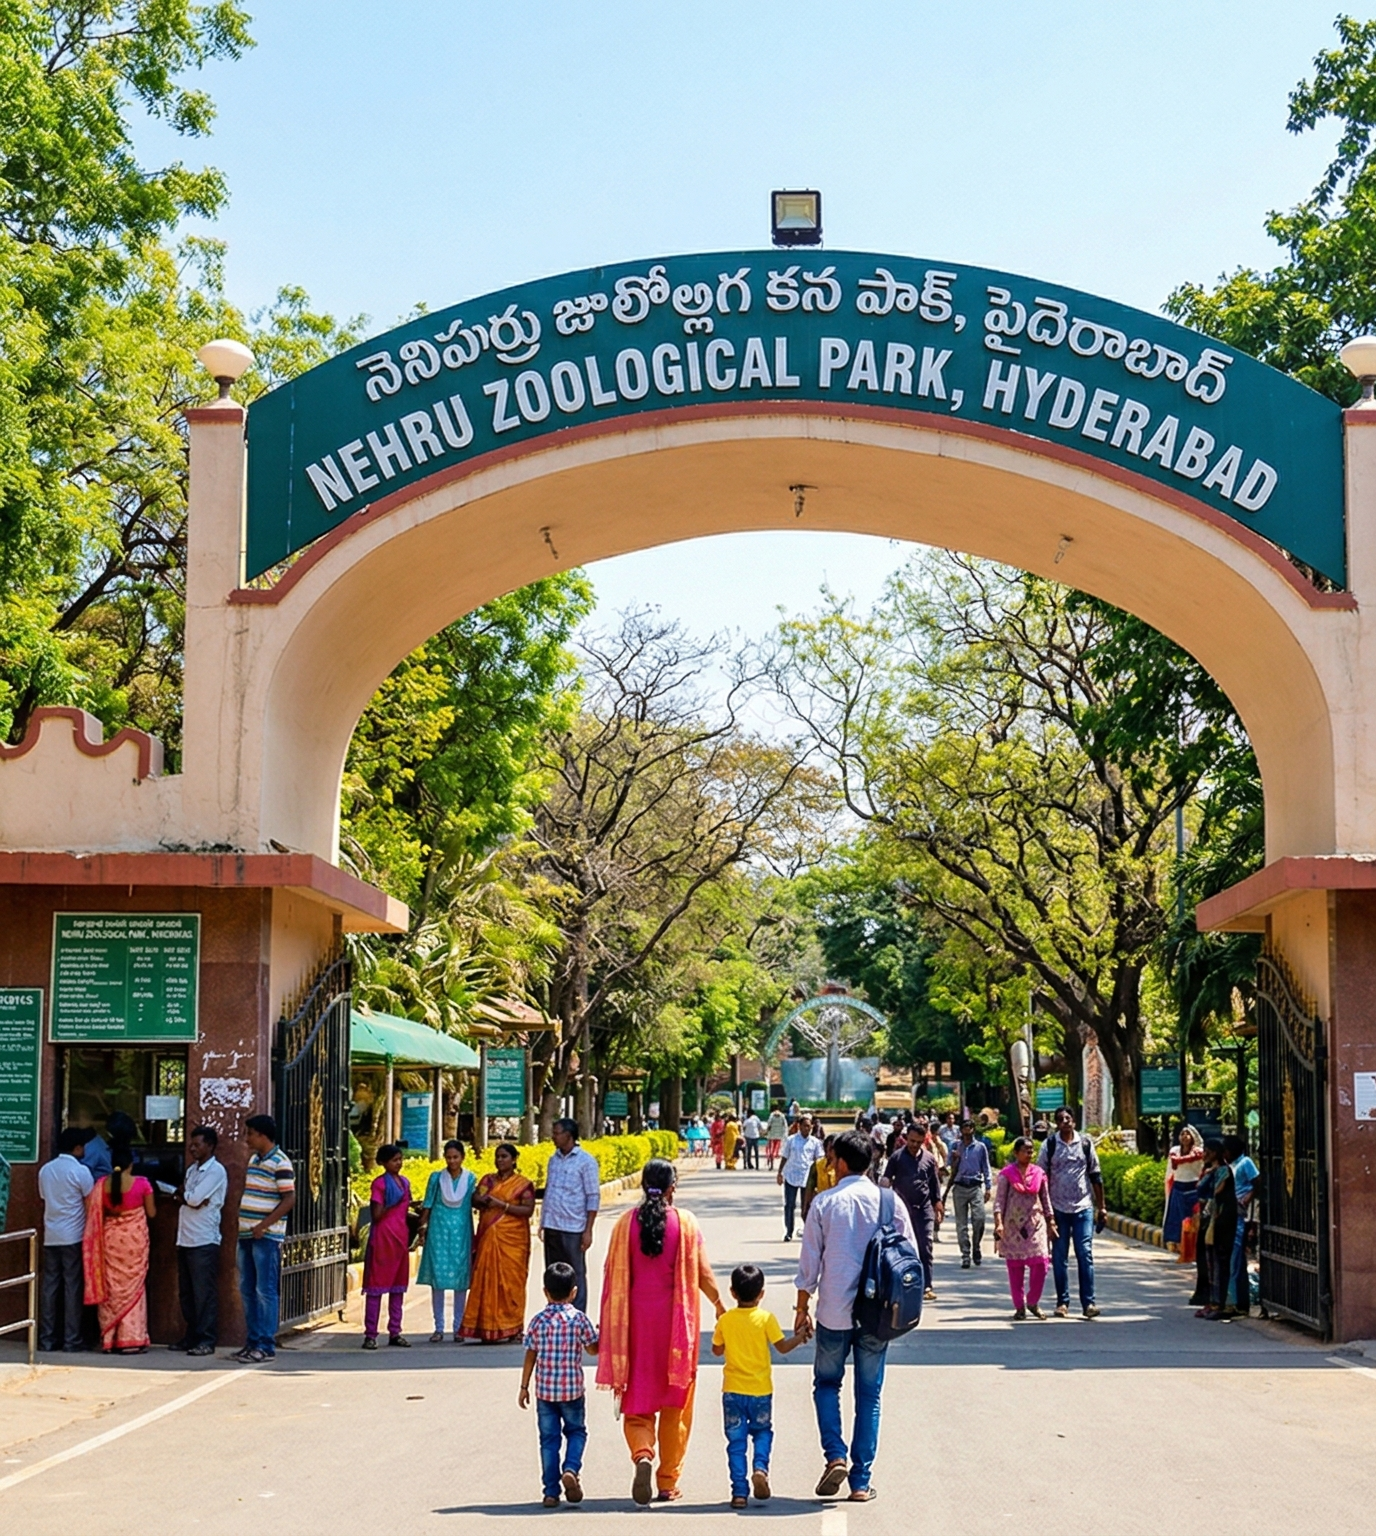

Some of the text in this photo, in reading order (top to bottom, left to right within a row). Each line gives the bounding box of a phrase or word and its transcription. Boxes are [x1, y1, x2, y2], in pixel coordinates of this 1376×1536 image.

[305, 337, 1278, 511] NEHRU ZOOLOGICAL PARK, HYDERABAD
